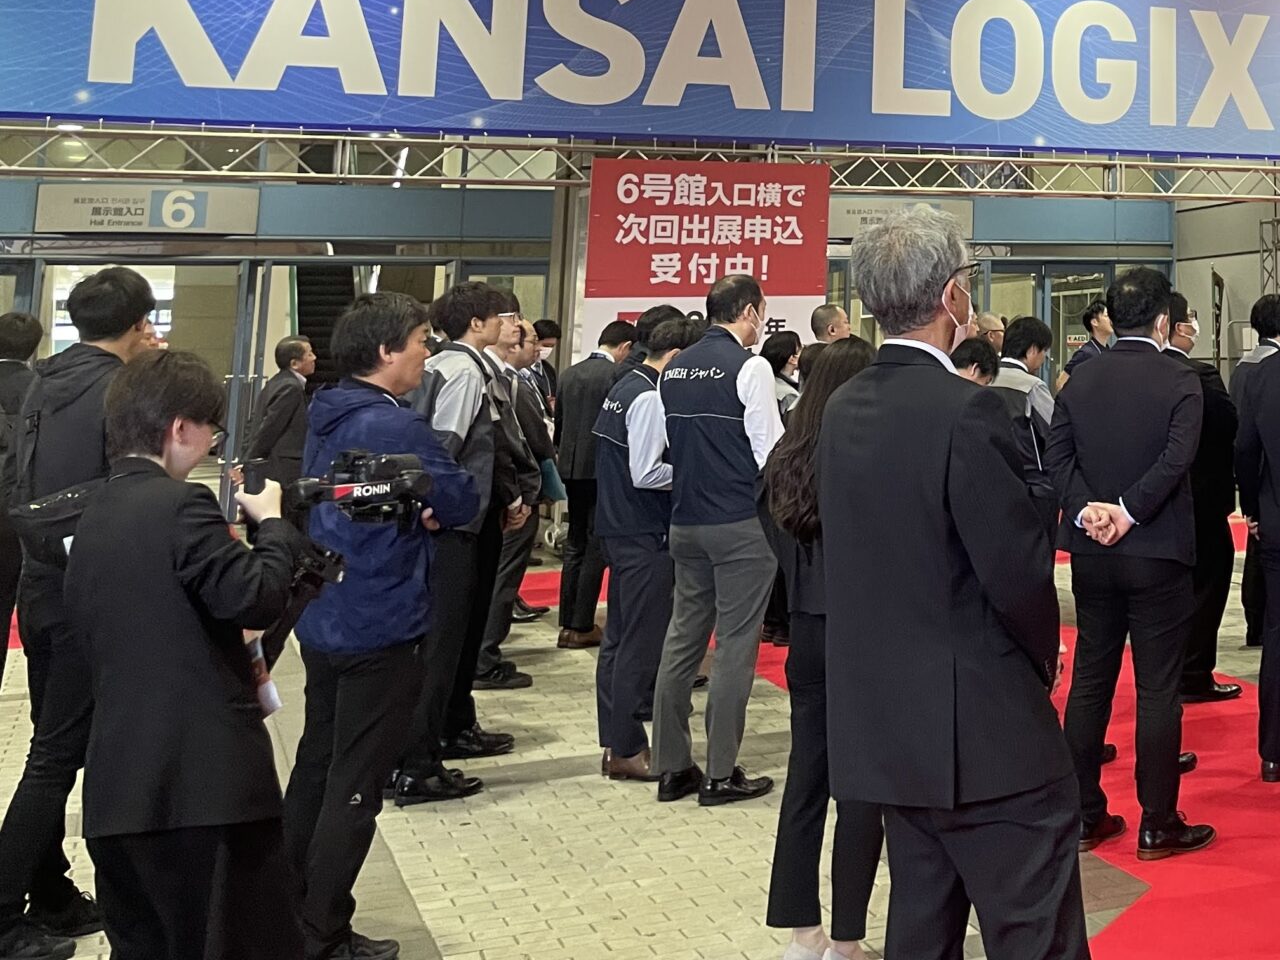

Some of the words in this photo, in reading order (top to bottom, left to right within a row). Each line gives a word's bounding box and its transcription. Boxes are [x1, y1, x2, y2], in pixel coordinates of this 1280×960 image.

[616, 172, 806, 208] 6号館入口横で
[161, 189, 196, 229] 6
[615, 213, 804, 246] 次回出展申込
[353, 483, 391, 497] RONIN
